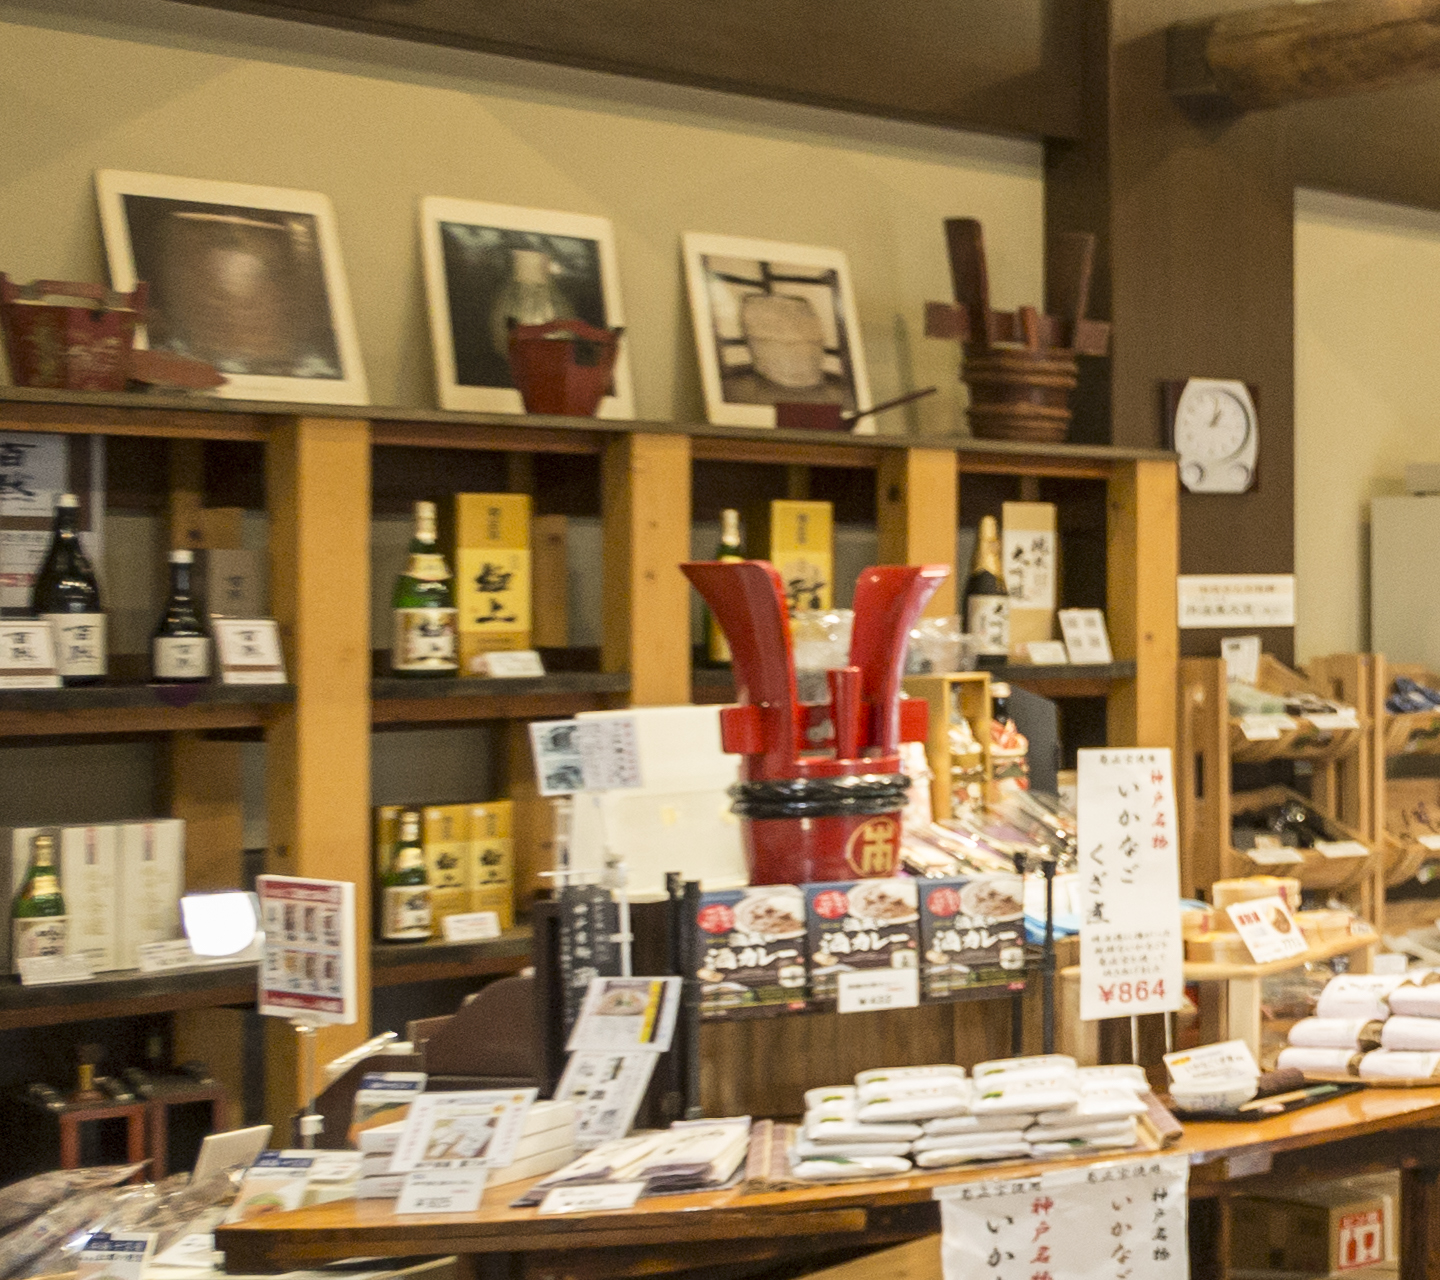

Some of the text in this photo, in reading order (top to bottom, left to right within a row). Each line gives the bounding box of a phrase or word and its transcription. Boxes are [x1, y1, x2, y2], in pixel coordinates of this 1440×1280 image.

[1118, 783, 1140, 884] いかなご
[1151, 771, 1169, 850] 神戸名物
[1087, 843, 1111, 925] くぎ煮
[1098, 979, 1166, 1005] ¥864
[1152, 1187, 1170, 1262] 神戸名物
